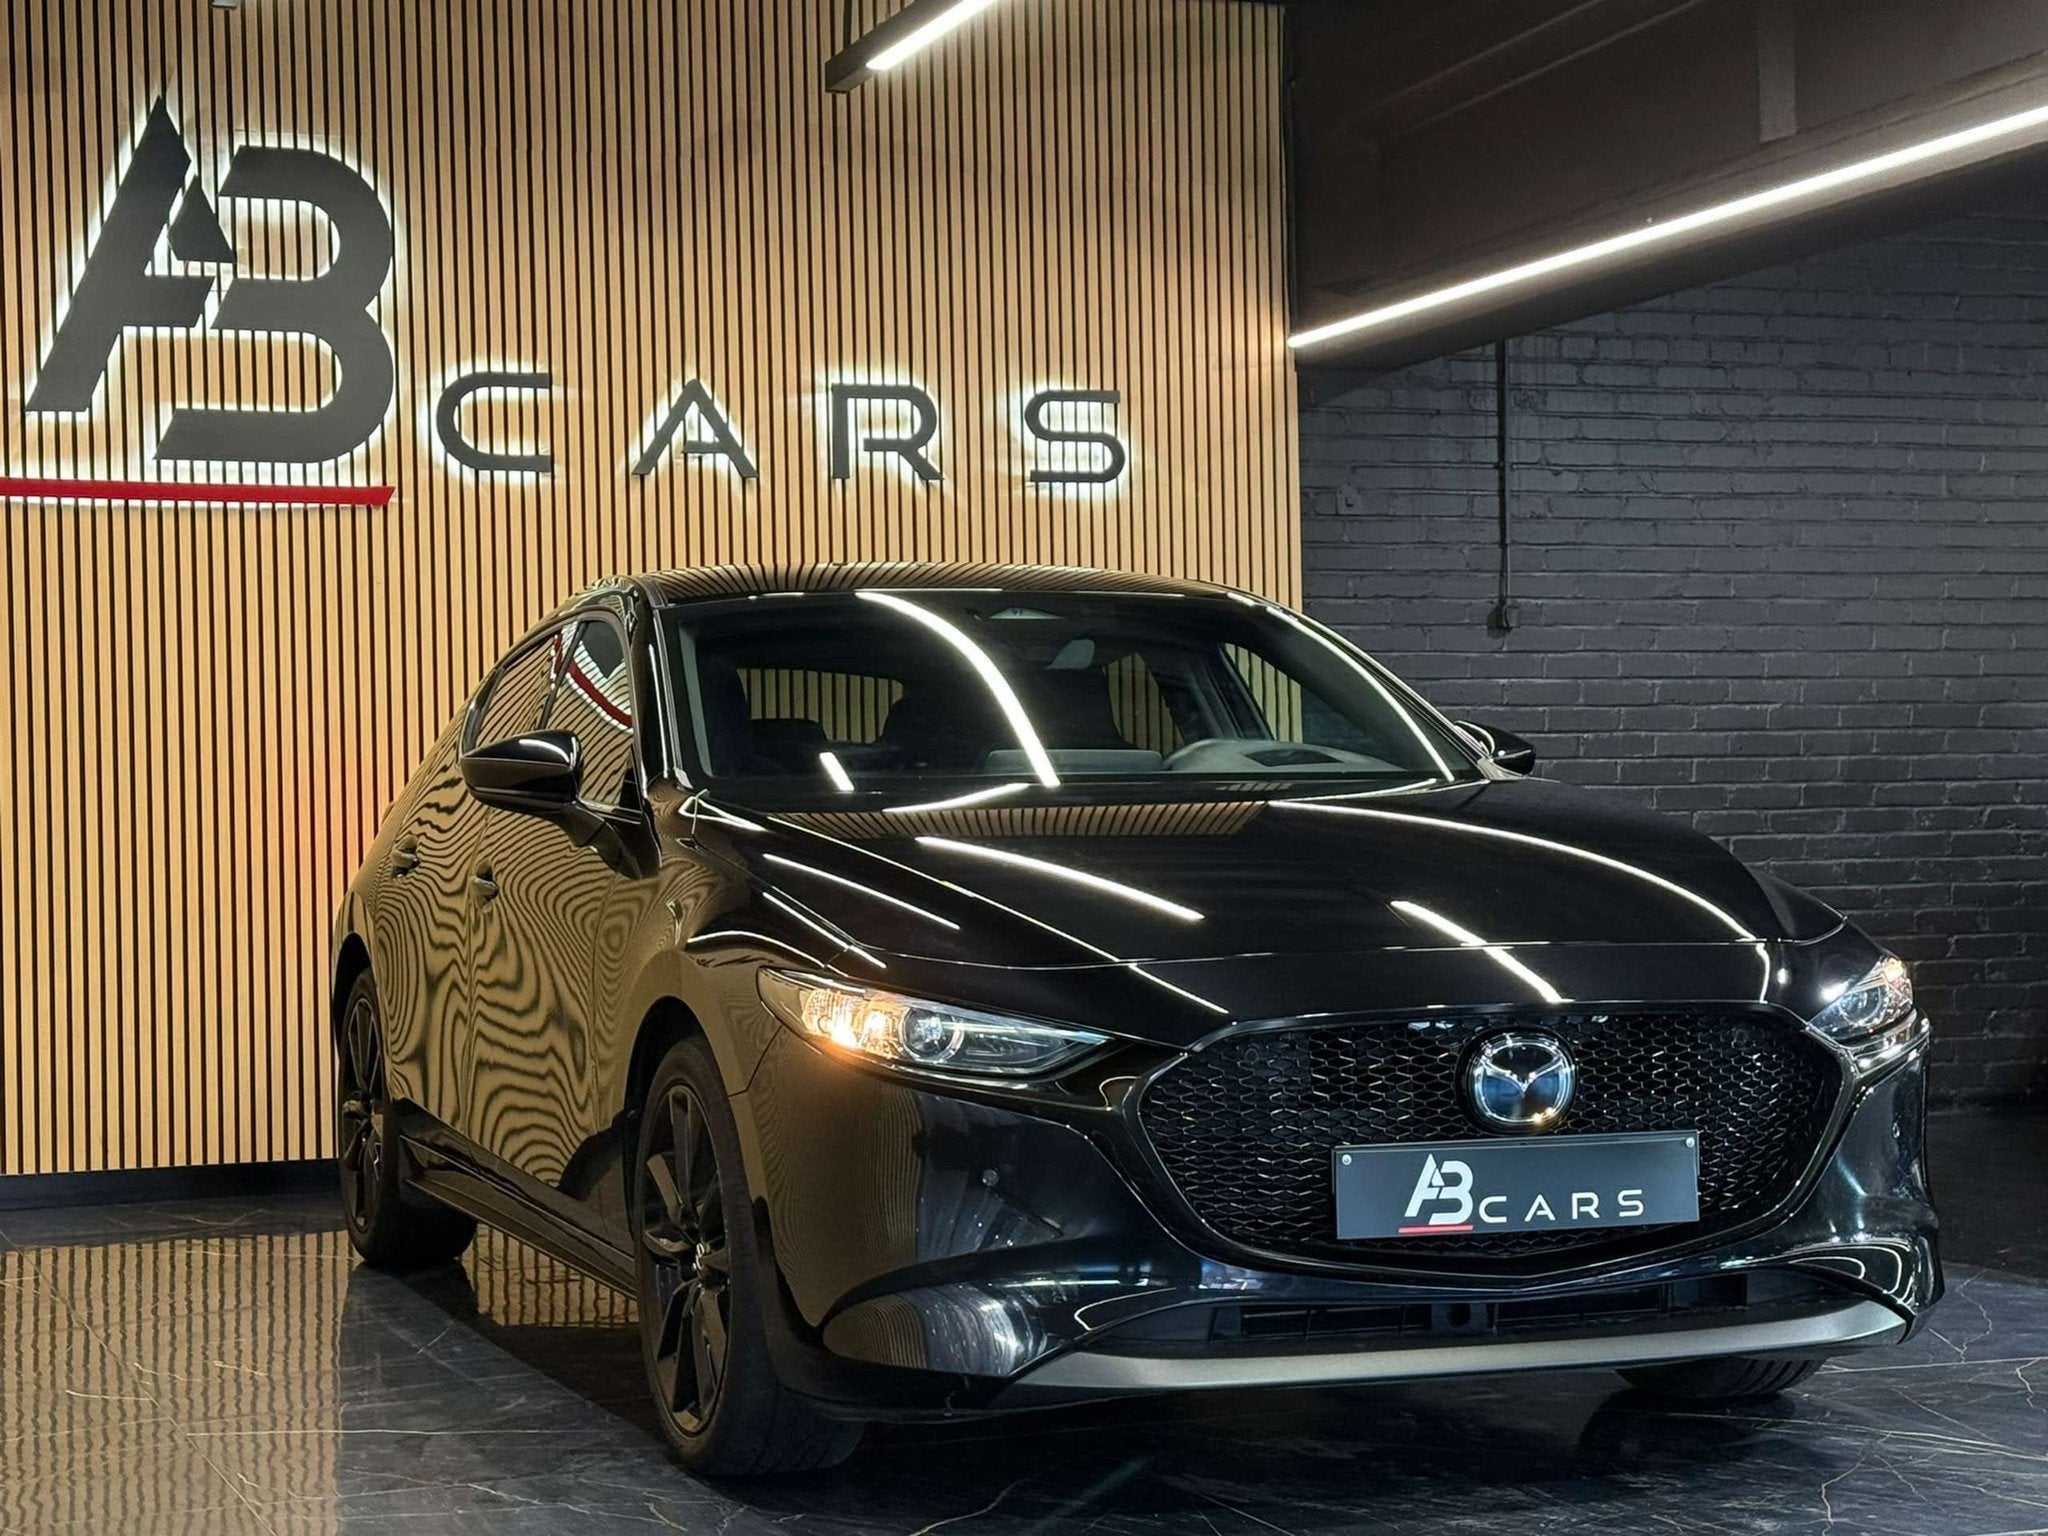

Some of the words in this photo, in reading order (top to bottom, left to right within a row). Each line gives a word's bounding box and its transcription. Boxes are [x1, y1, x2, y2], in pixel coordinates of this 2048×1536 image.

[25, 95, 395, 464] AB
[436, 371, 1127, 484] CARS
[1404, 1153, 1474, 1225] AB
[1478, 1189, 1645, 1223] CARS
